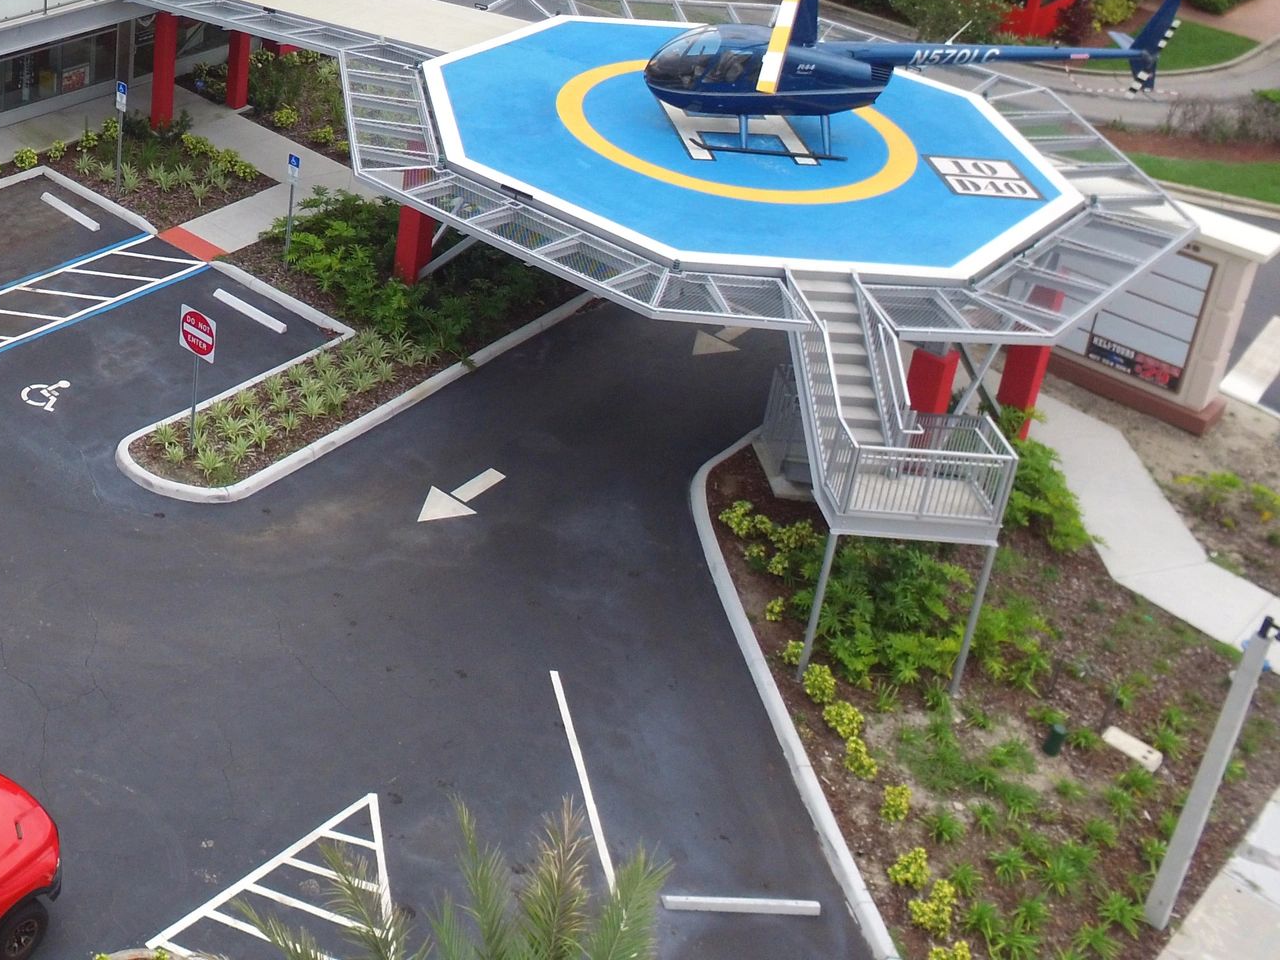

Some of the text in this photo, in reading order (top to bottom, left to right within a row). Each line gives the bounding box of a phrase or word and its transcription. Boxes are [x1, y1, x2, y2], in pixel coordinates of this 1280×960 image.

[951, 160, 998, 176] 10
[953, 179, 1028, 195] D40
[186, 315, 211, 334] DO NOT
[187, 334, 207, 351] ENTER
